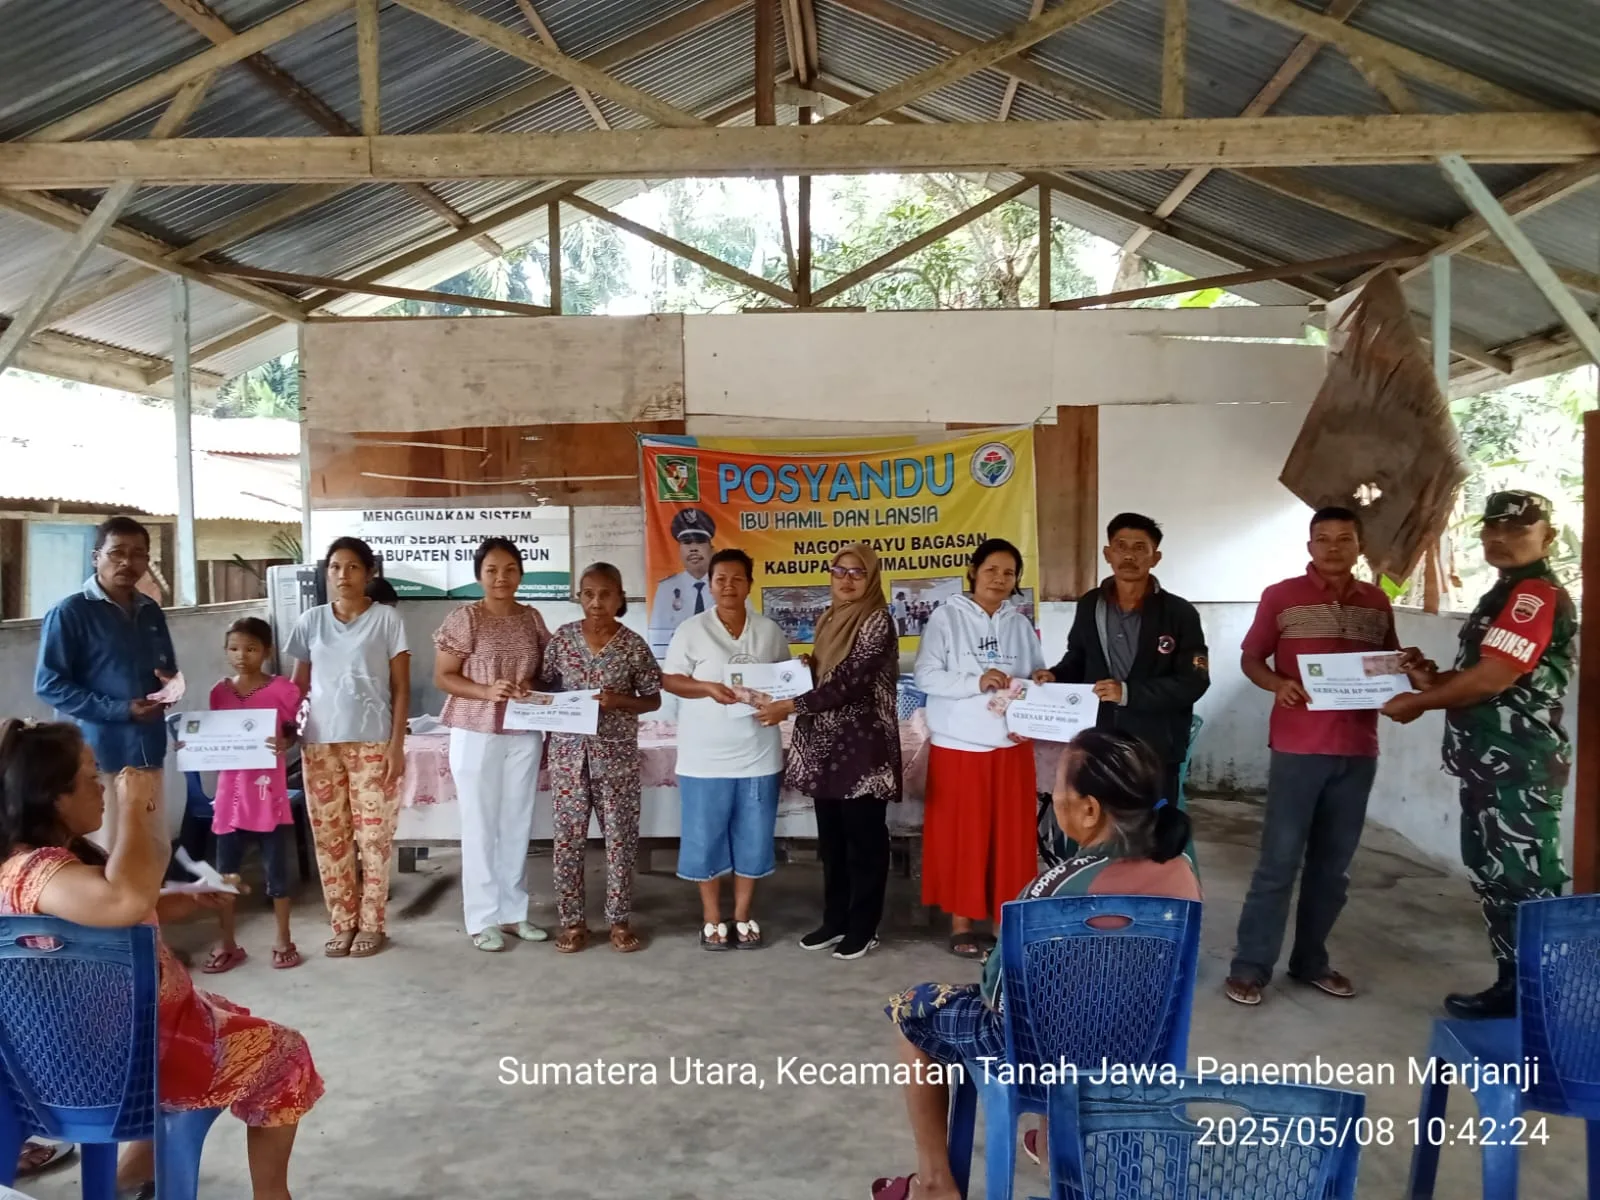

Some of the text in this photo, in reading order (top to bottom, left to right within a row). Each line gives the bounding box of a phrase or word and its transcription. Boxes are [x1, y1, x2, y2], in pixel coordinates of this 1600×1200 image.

[718, 453, 954, 504] POSYANDU
[363, 511, 475, 521] MENGGUNAKAN
[740, 505, 939, 530] IBU HAMIL DAN LANSIA
[360, 535, 405, 544] ANAM
[794, 540, 855, 555] NAGO
[911, 532, 987, 551] BAGASAN
[374, 549, 450, 561] ABUPATEN
[764, 553, 975, 575] KABUPA IMALUNGUN
